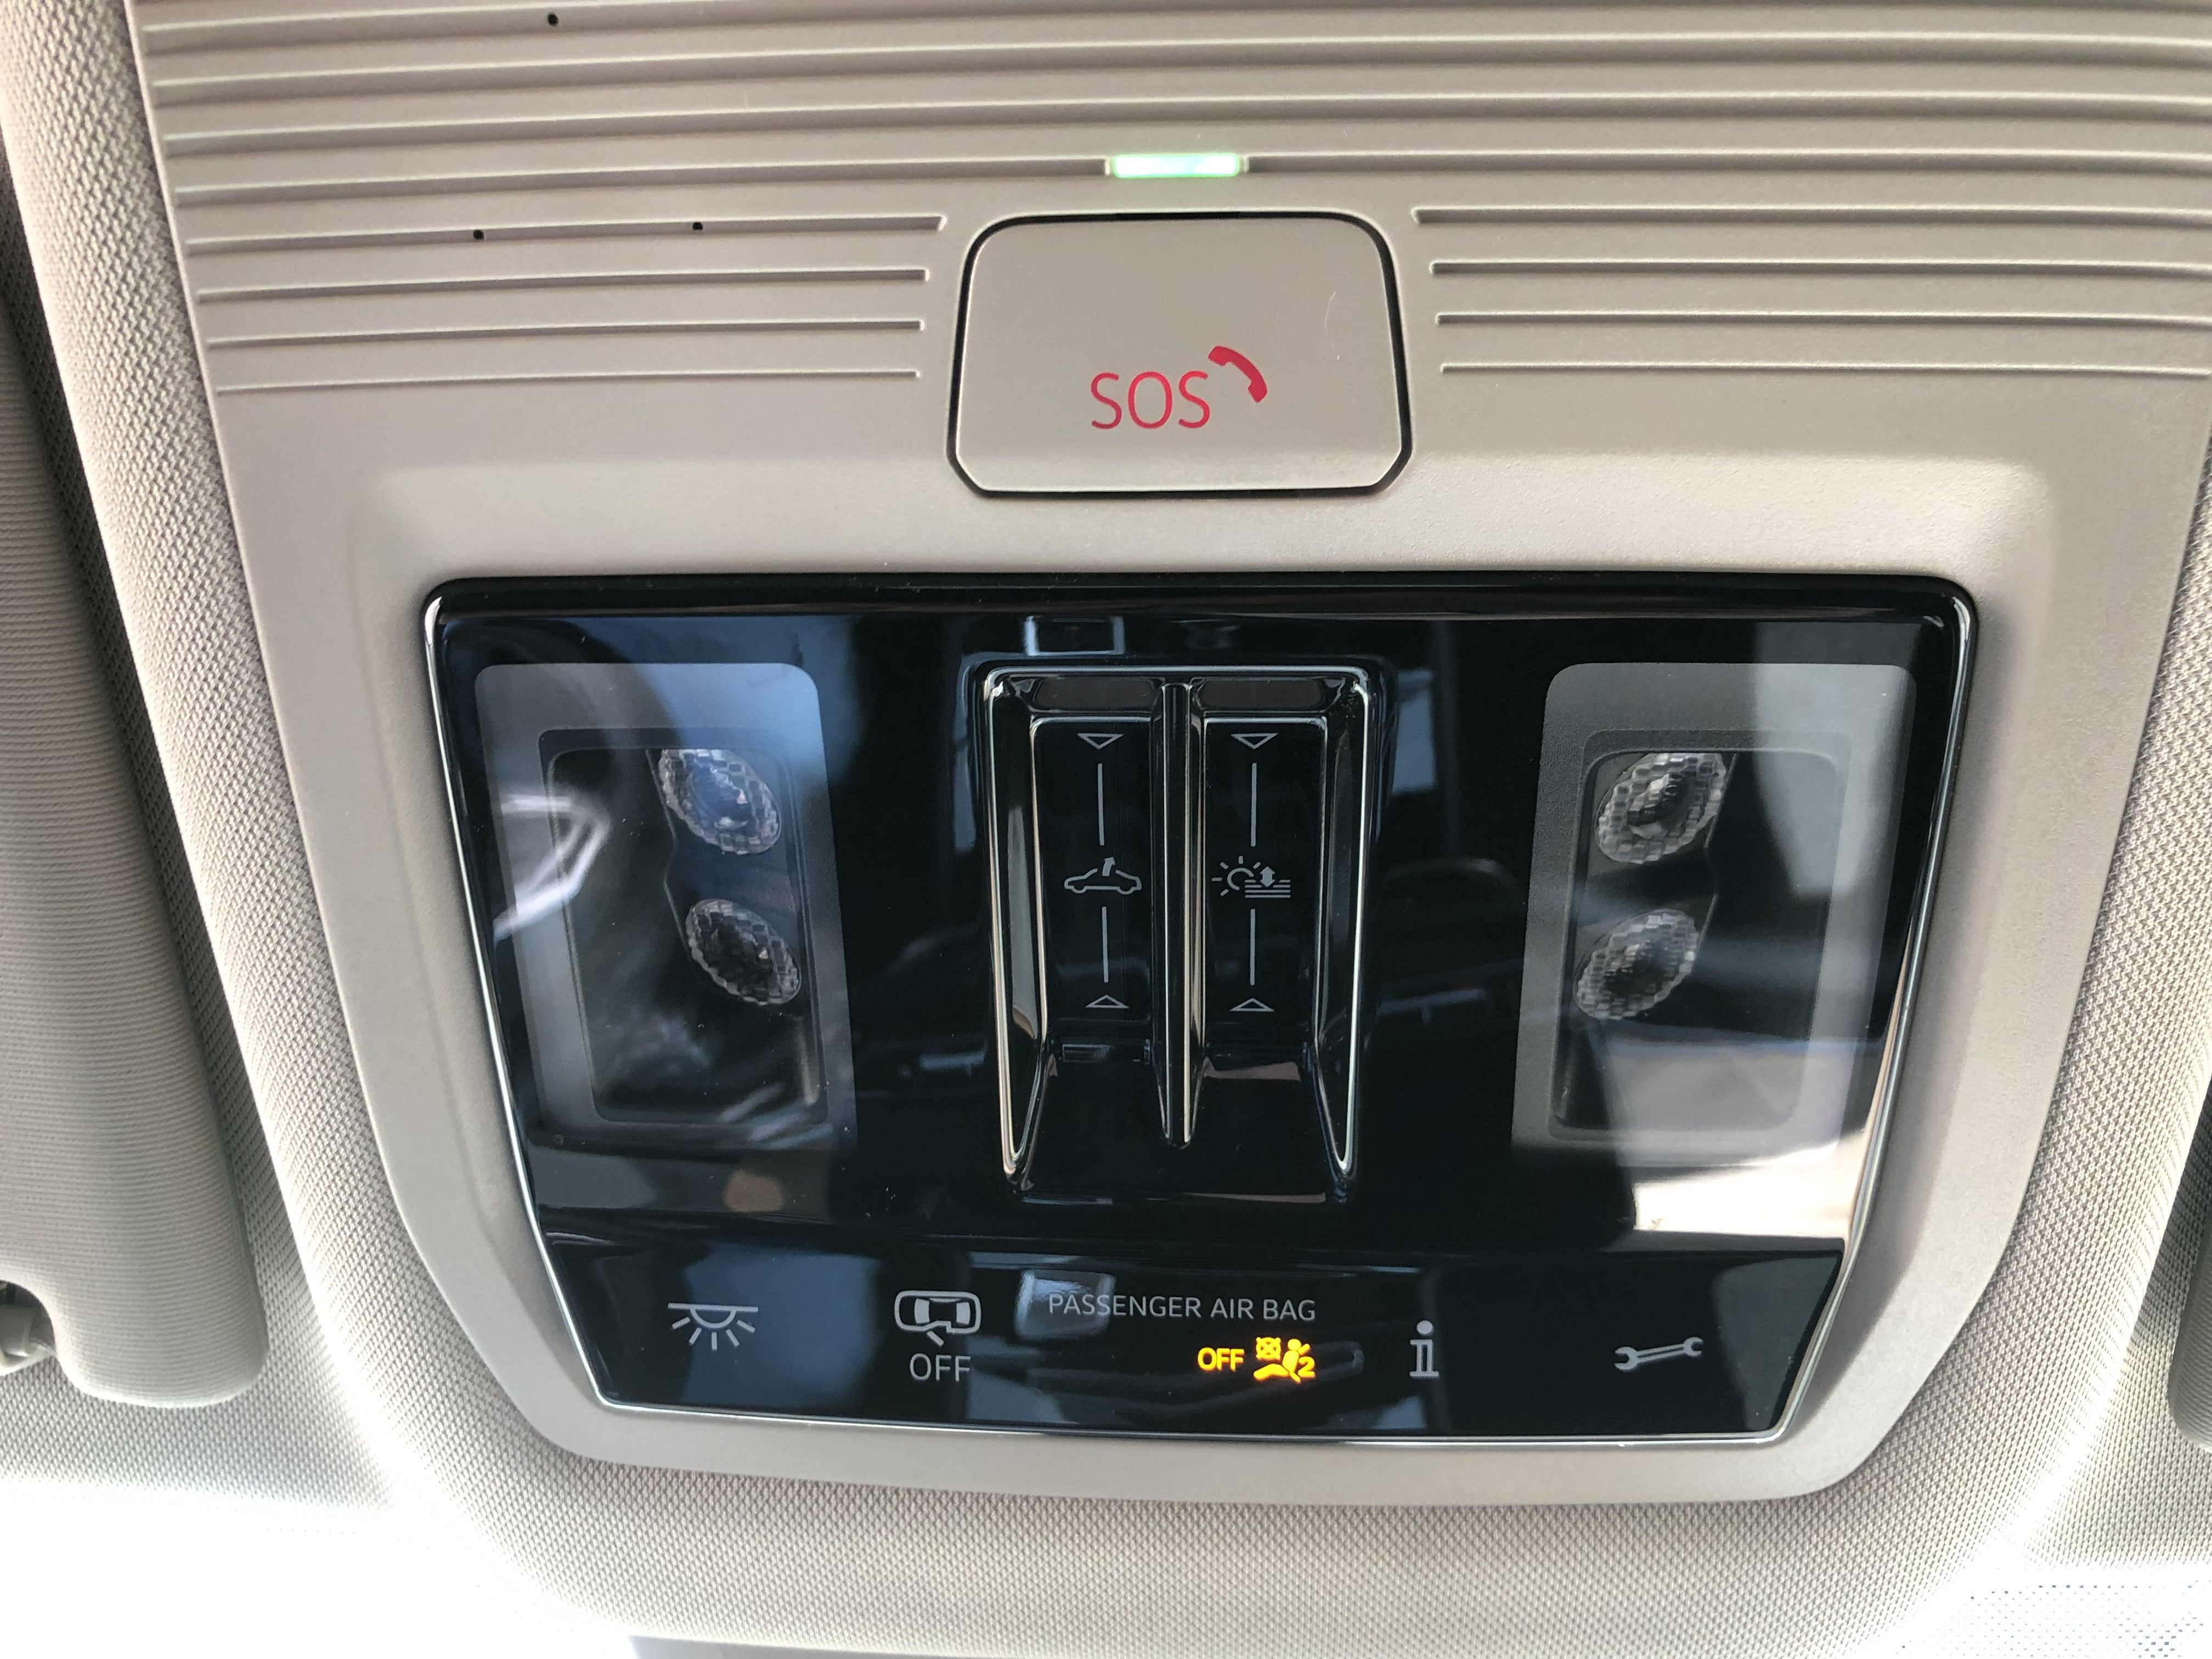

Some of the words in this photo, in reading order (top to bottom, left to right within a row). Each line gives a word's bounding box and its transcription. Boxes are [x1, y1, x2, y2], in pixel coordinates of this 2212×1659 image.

[1090, 370, 1211, 430] SOS
[1048, 1294, 1201, 1318] PASSENGER
[1210, 1297, 1255, 1320] AIR
[1262, 1299, 1316, 1322] BAG
[909, 1353, 971, 1382] OFF
[1197, 1347, 1245, 1372] OFF
[1297, 1356, 1316, 1378] 2
